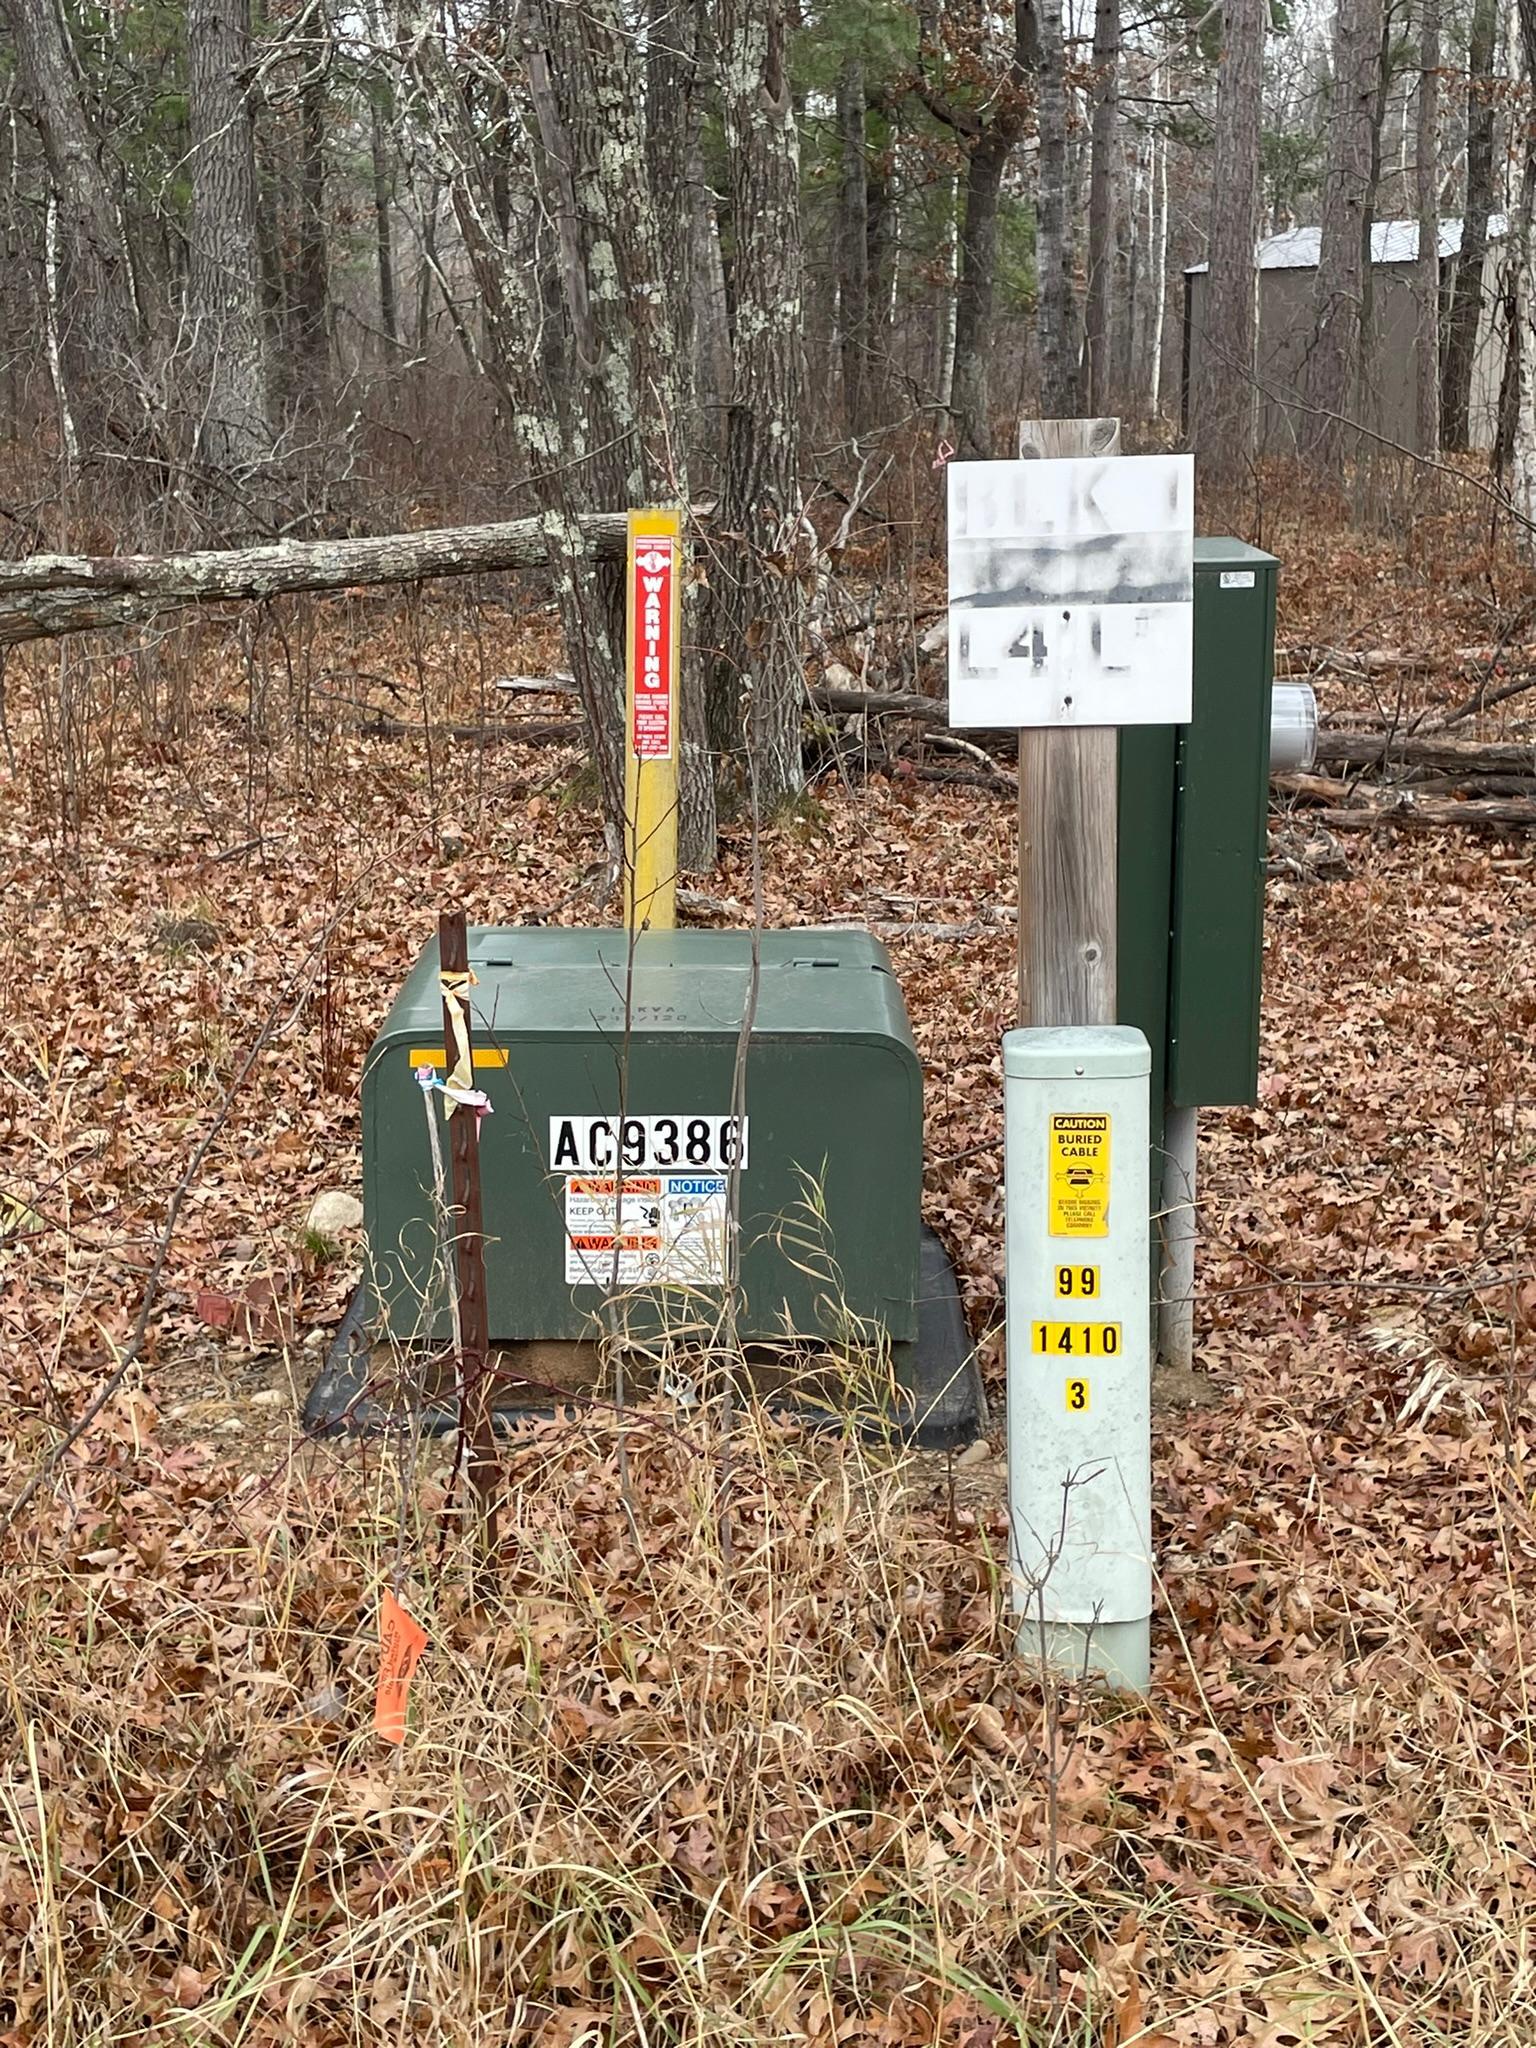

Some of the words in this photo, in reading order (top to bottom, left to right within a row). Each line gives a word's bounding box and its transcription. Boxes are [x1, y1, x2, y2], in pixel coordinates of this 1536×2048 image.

[642, 576, 664, 688] WARNING
[1055, 1118, 1105, 1129] CAUTION
[554, 1119, 745, 1167] AC9386
[1058, 1134, 1103, 1144] BURIED
[1061, 1147, 1099, 1157] CABLE
[569, 1207, 595, 1216] KEEP
[596, 1207, 616, 1216] OUT
[1059, 1267, 1095, 1296] 99
[1039, 1325, 1117, 1354] 1410
[1071, 1381, 1085, 1410] 3
